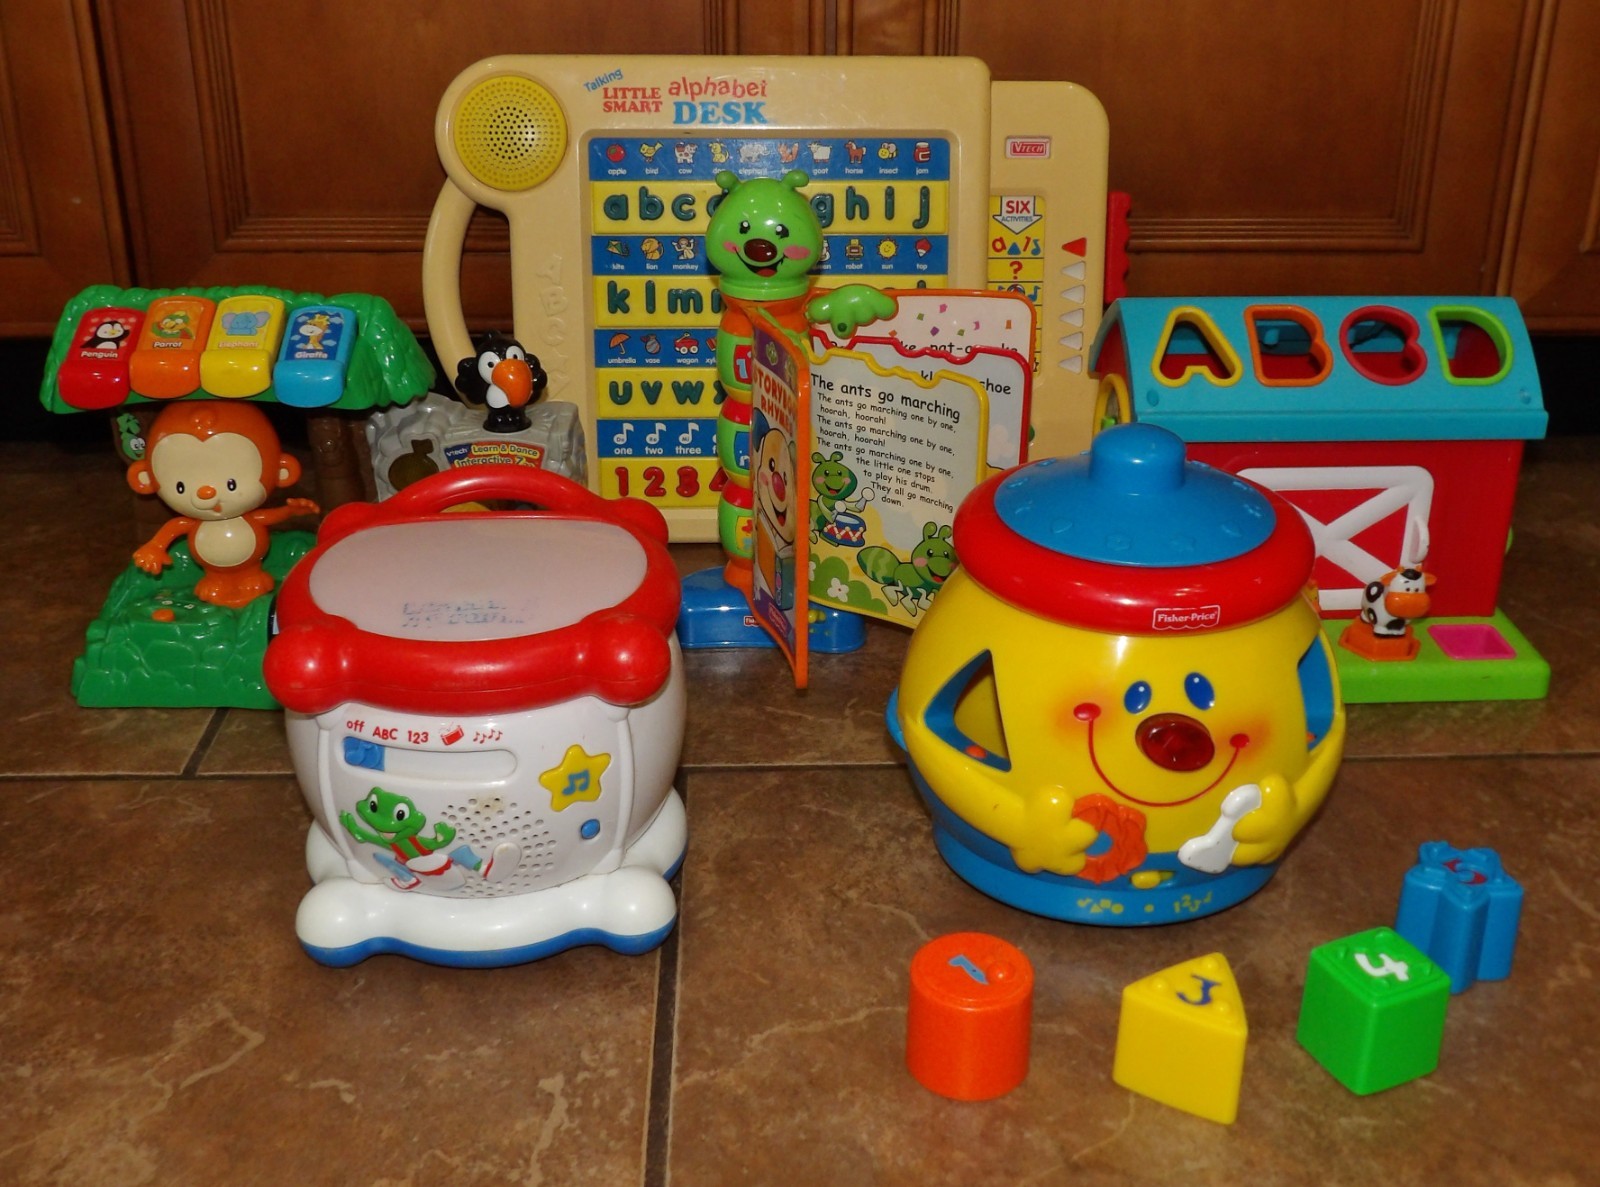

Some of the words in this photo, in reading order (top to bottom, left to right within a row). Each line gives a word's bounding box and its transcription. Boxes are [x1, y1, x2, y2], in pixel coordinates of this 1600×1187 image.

[583, 68, 623, 92] Talking
[668, 76, 767, 101] alphabet
[603, 87, 662, 100] LITTLE
[603, 100, 663, 113] SMART
[672, 101, 768, 125] DESK
[607, 168, 627, 176] apple
[603, 194, 629, 220] a
[639, 185, 665, 221] b
[671, 193, 696, 221] c
[845, 186, 869, 221] h
[1005, 200, 1031, 214] SIX
[1001, 215, 1033, 223] ACTIVITIES
[672, 263, 699, 271] monkey
[916, 263, 928, 271] top
[607, 280, 630, 314] k
[667, 288, 703, 314] m
[81, 351, 118, 359] Penguin
[294, 351, 328, 359] Giraffe
[609, 381, 633, 406] u
[641, 380, 663, 406] v
[671, 380, 704, 405] w
[811, 373, 834, 391] The
[840, 384, 872, 398] ants
[878, 391, 894, 404] go
[900, 394, 960, 424] marching
[817, 392, 832, 403] The
[835, 398, 853, 407] ants
[856, 402, 867, 411] go
[870, 404, 907, 420] marching
[910, 414, 924, 423] one
[927, 417, 937, 428] by
[940, 422, 956, 433] one,
[820, 404, 850, 419] hoorah,
[855, 411, 886, 425] hoorah!
[817, 414, 831, 425] The
[834, 420, 853, 430] ants
[856, 425, 866, 433] go
[869, 426, 907, 442] marching
[909, 436, 923, 445] one
[926, 438, 937, 450] by
[939, 444, 955, 456] one,
[819, 427, 850, 441] hoorah,
[854, 434, 886, 447] hoorah!
[456, 456, 512, 468] Interactive
[472, 444, 499, 455] Learn
[501, 444, 507, 452] &
[509, 445, 538, 457] Dance
[614, 447, 633, 455] one
[645, 446, 664, 455] two
[675, 445, 702, 455] three
[816, 437, 831, 448] The
[834, 442, 852, 452] ants
[855, 447, 866, 456] go
[868, 448, 906, 465] marching
[908, 458, 922, 468] one
[925, 461, 935, 473] by
[938, 467, 954, 479] one,
[856, 456, 870, 466] the
[873, 459, 894, 471] little
[897, 466, 911, 476] one
[914, 470, 935, 483] stops
[863, 469, 872, 477] to
[875, 472, 892, 484] play
[895, 476, 907, 486] his
[910, 481, 933, 494] drum.
[643, 466, 667, 497] 2
[675, 466, 700, 498] 3
[870, 481, 891, 494] They
[894, 487, 905, 496] all
[907, 492, 917, 501] go
[919, 494, 954, 514] marching
[1157, 612, 1217, 622] Fisher-Price
[347, 720, 365, 733] off
[372, 726, 398, 740] ABC
[407, 730, 429, 744] 123
